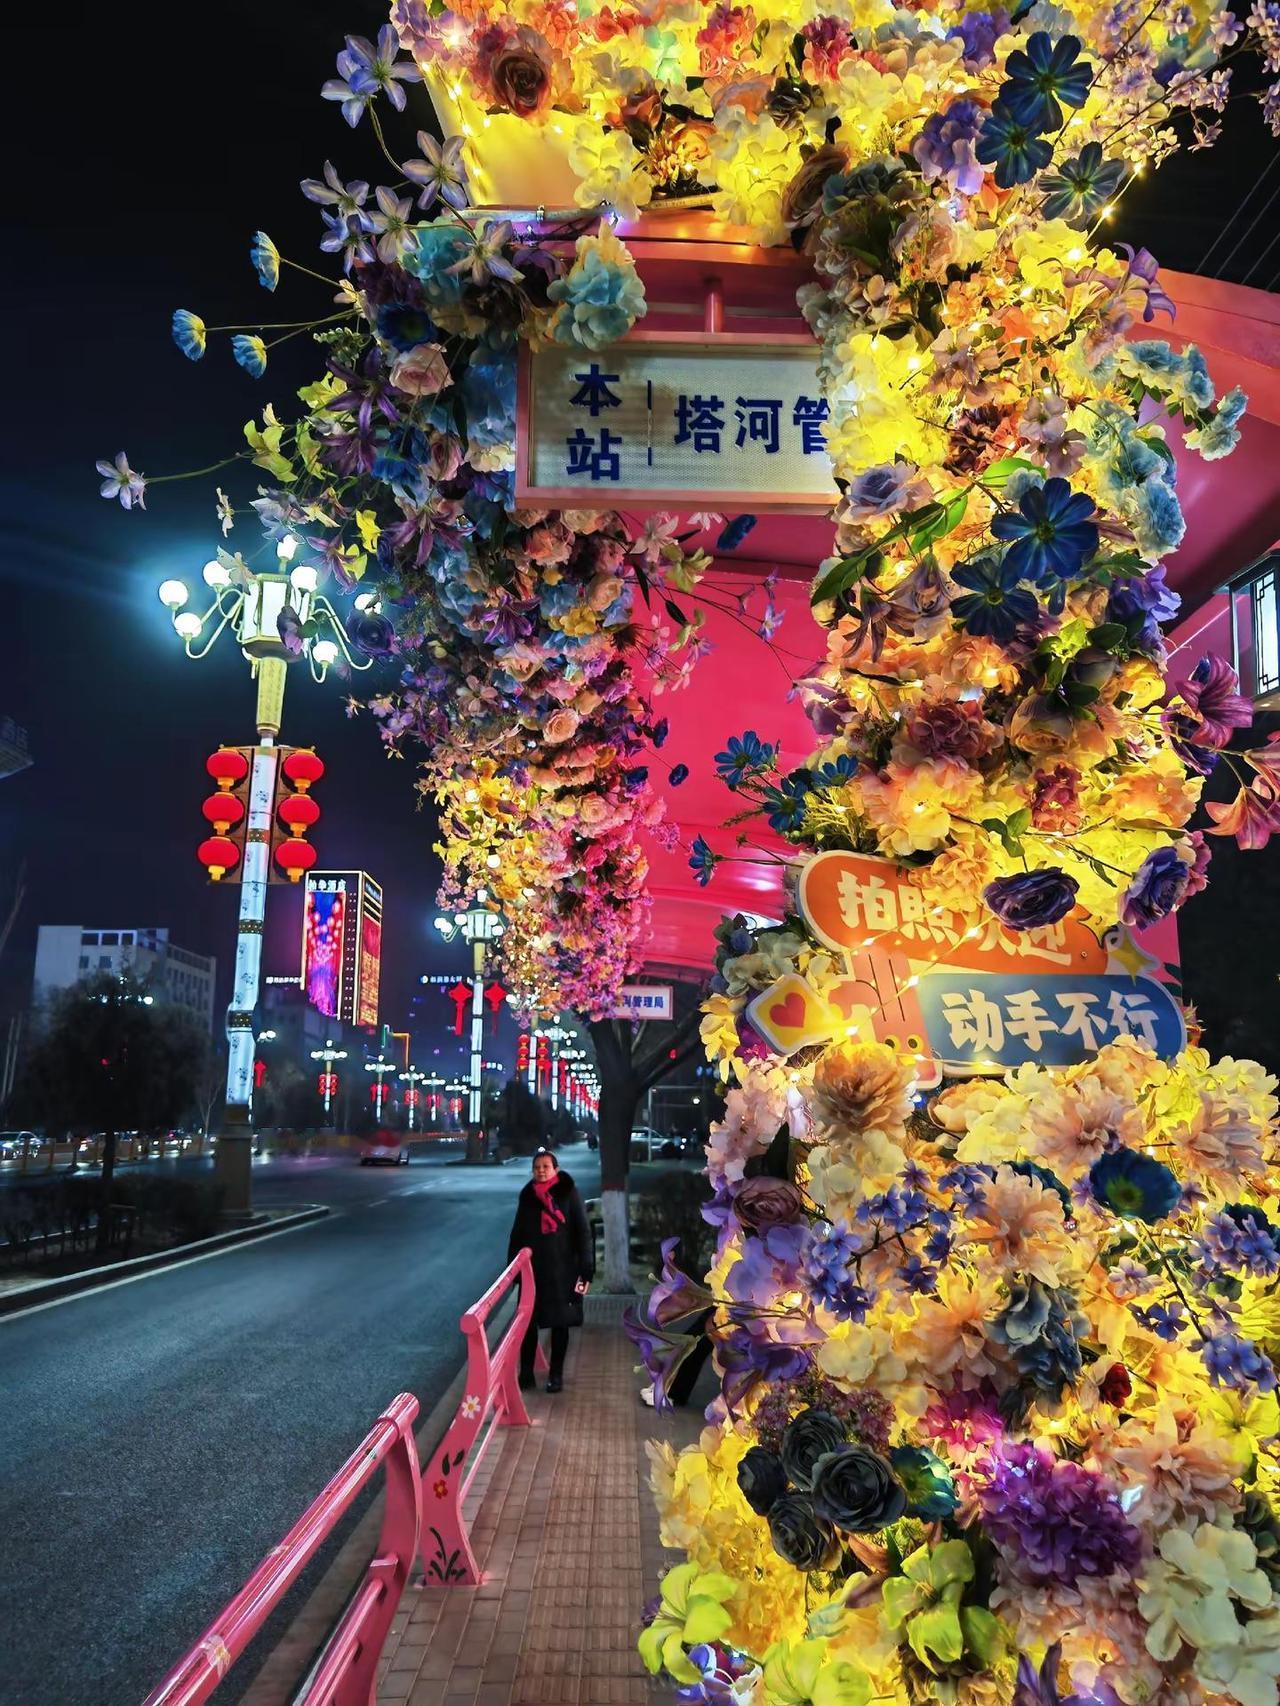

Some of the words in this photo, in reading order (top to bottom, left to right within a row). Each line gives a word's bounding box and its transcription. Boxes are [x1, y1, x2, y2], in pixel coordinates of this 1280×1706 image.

[566, 364, 622, 480] 本站
[941, 989, 1159, 1053] 动手不行
